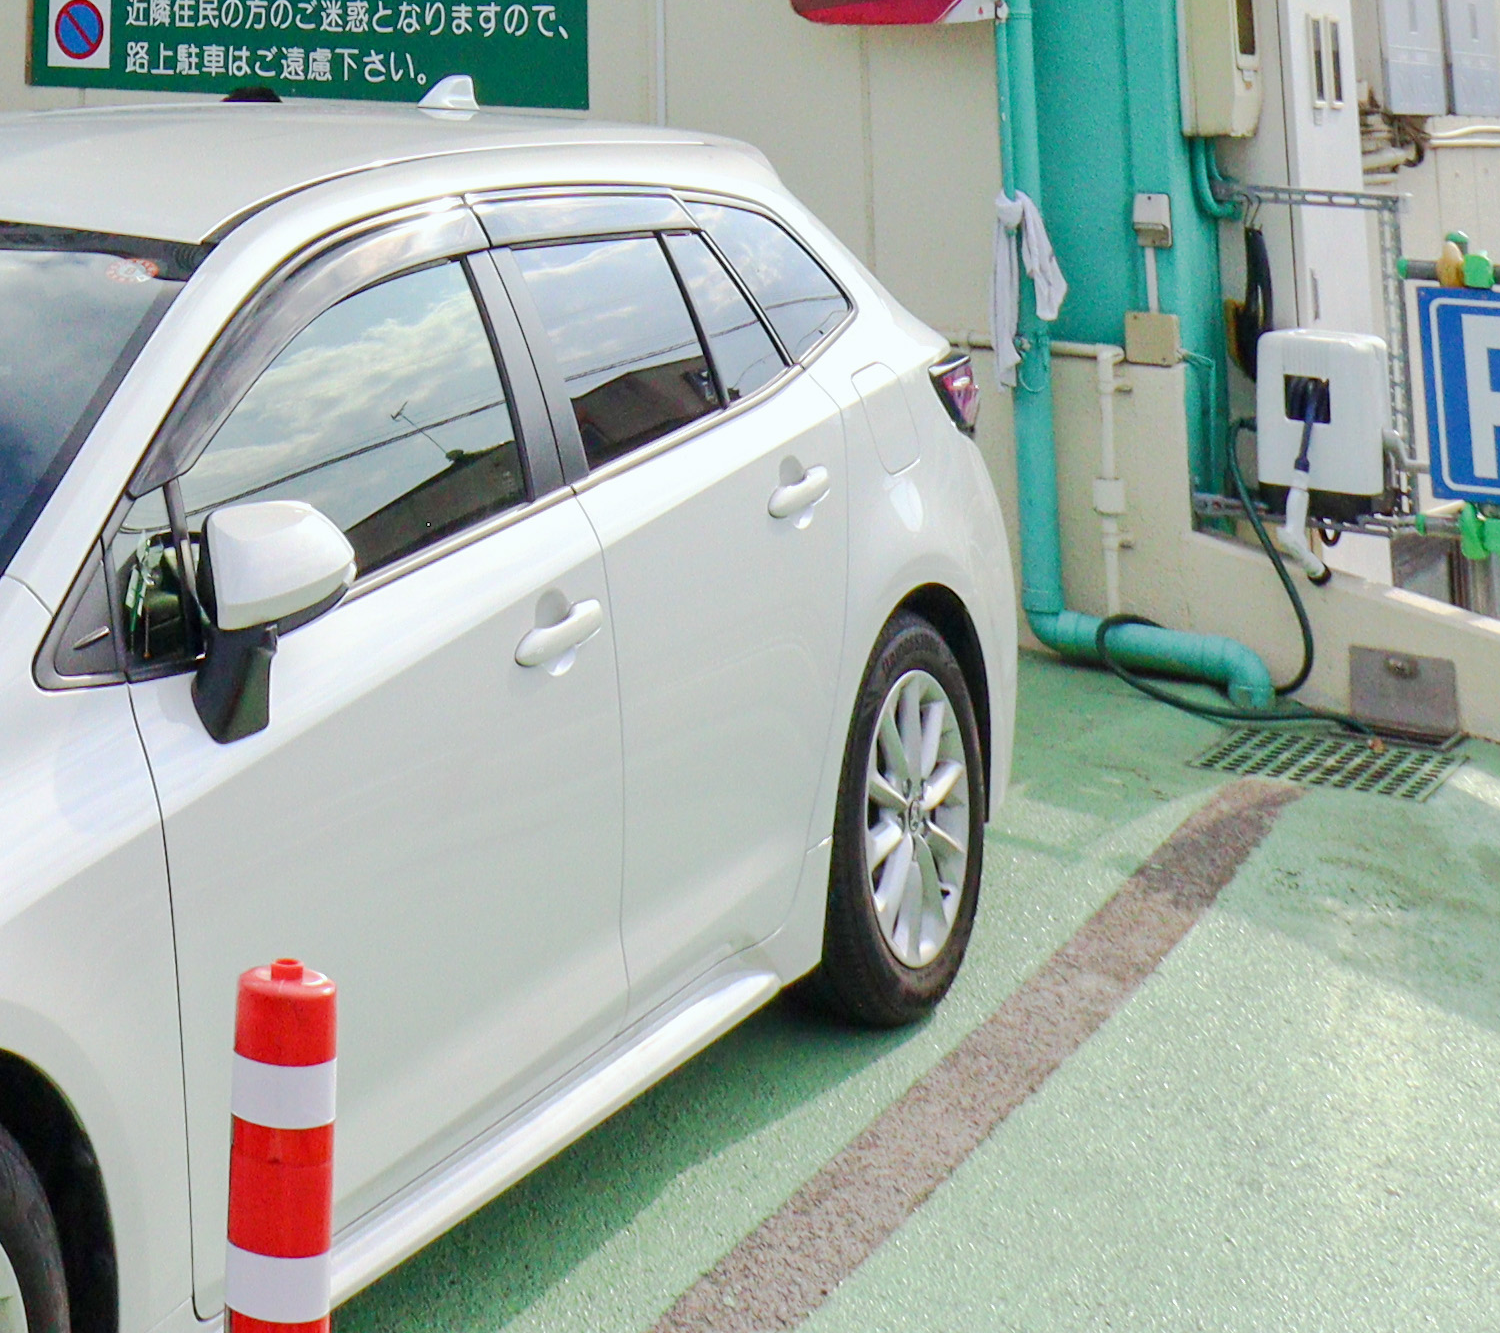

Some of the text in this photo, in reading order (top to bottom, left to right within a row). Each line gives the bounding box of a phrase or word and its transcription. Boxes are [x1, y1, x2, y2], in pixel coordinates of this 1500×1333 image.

[125, 42, 428, 86] 路上駐車はご遠慮下さい。
